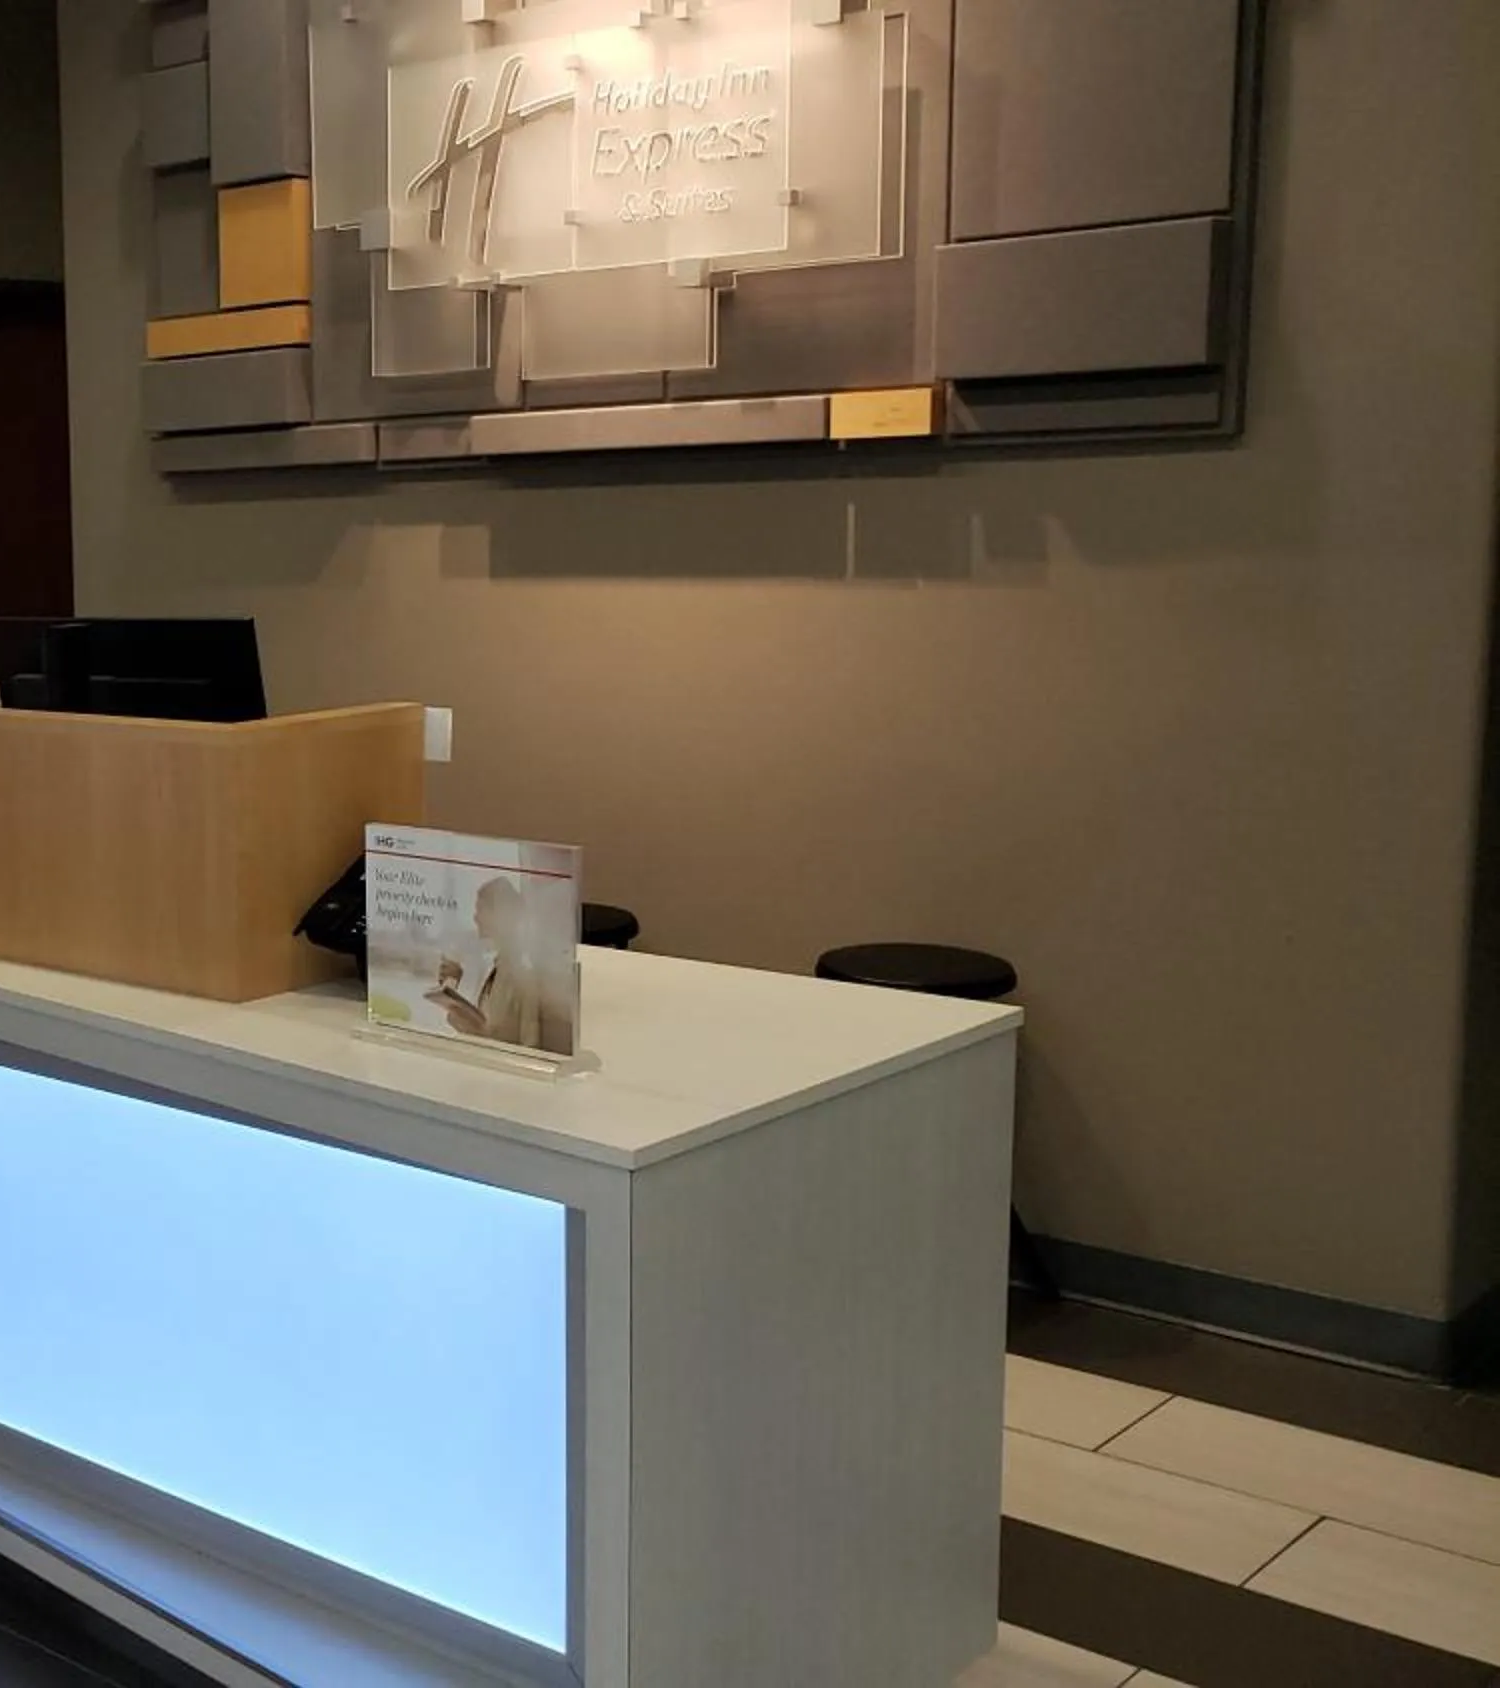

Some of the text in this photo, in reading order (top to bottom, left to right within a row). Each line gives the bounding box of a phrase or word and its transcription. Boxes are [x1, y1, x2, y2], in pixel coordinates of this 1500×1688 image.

[593, 62, 771, 115] Holiday Inn
[590, 114, 771, 184] Express
[618, 187, 735, 224] & Suites
[373, 834, 396, 849] IHG
